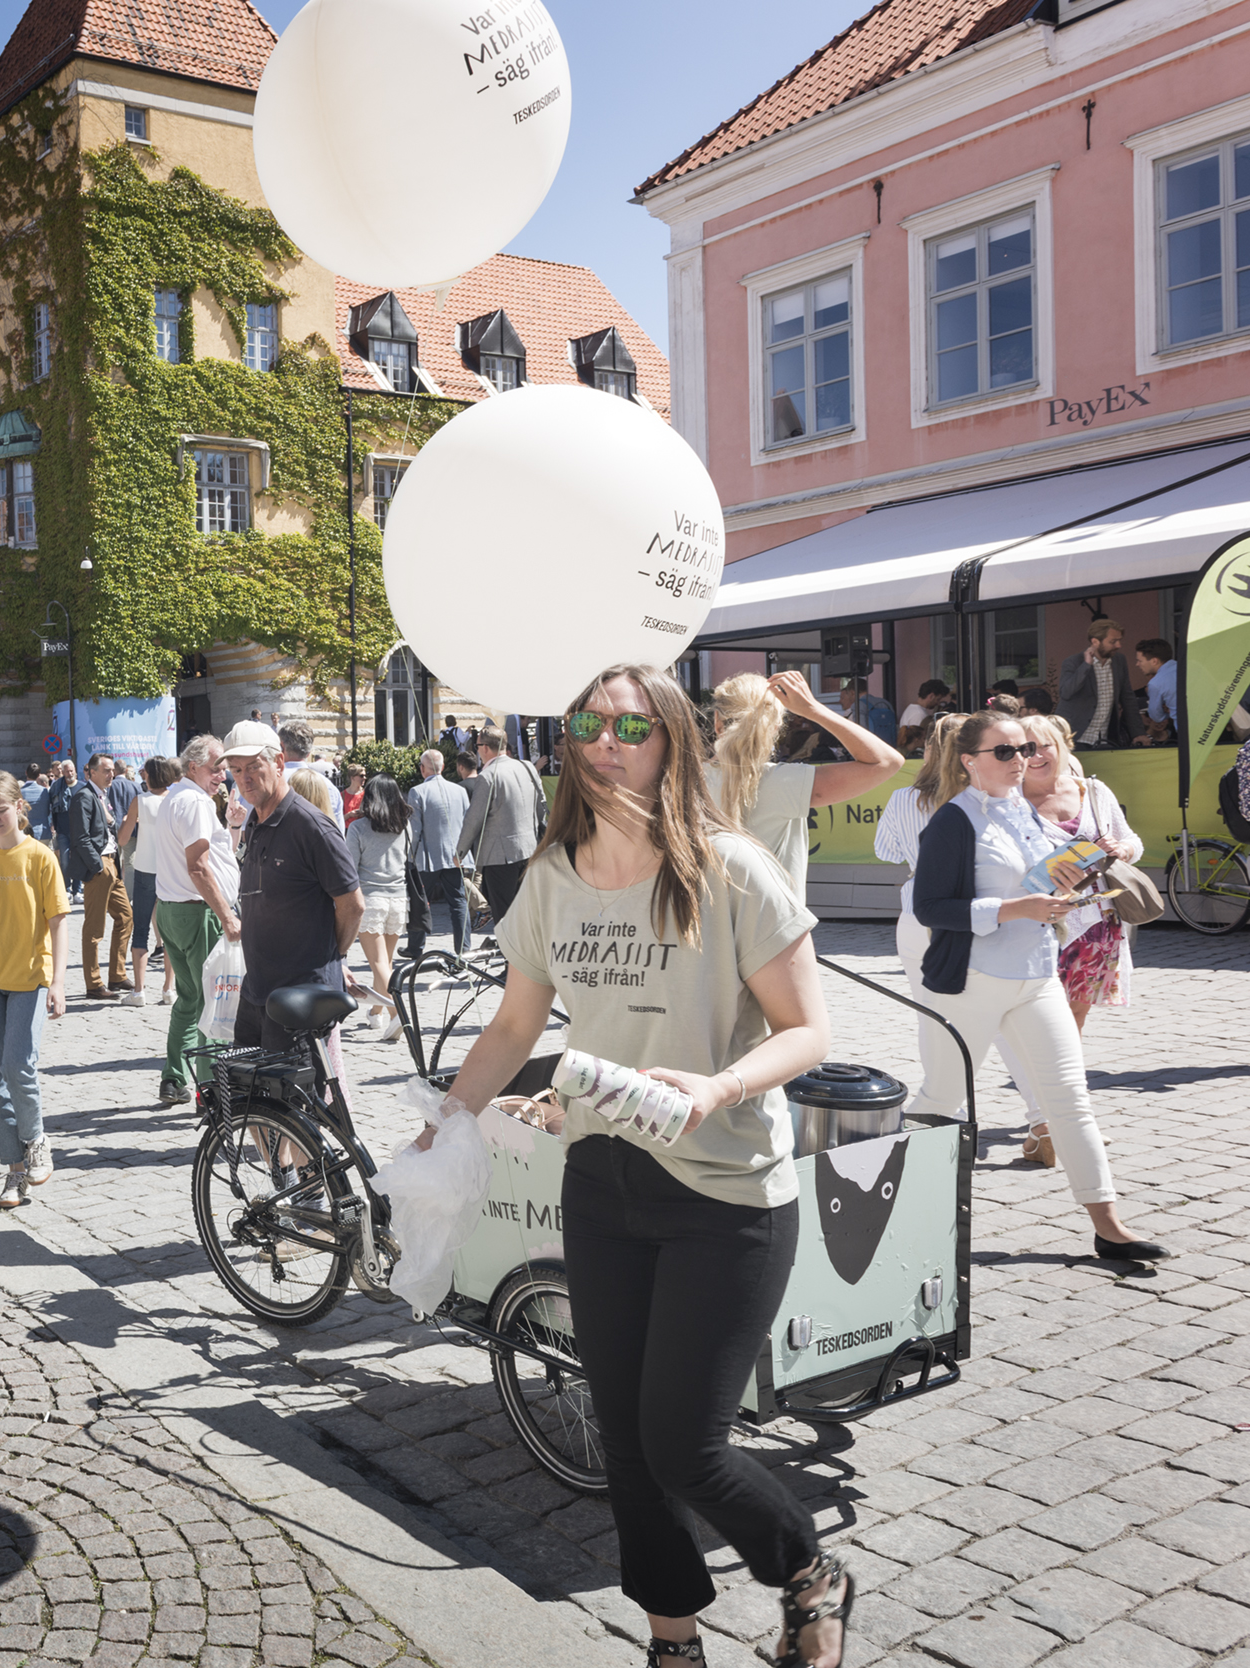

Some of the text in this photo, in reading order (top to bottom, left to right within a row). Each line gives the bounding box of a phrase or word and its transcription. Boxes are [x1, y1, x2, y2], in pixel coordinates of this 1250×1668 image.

[460, 9, 497, 36] Var
[494, 53, 530, 88] säg
[525, 28, 559, 66] ifrån!
[512, 85, 562, 125] TESKEDSORDEN
[674, 509, 719, 547] Var inte
[655, 561, 688, 598] säg
[687, 567, 716, 601] ifrån!
[640, 615, 690, 637] TESKEDSORDEN
[1197, 651, 1250, 746] Naturskyddsföreninge
[87, 735, 121, 743] SVERIGES
[91, 743, 111, 751] LÄNK
[126, 742, 155, 750] VÄRLDEN
[581, 921, 637, 938] Var inte
[550, 940, 678, 971] MEDRASIST
[571, 967, 600, 988] säg
[603, 968, 646, 987] ifrån!
[627, 1005, 667, 1015] TESKEDSORDEN
[488, 1199, 521, 1222] INTE
[815, 1320, 893, 1356] TESKEDSORDEN
